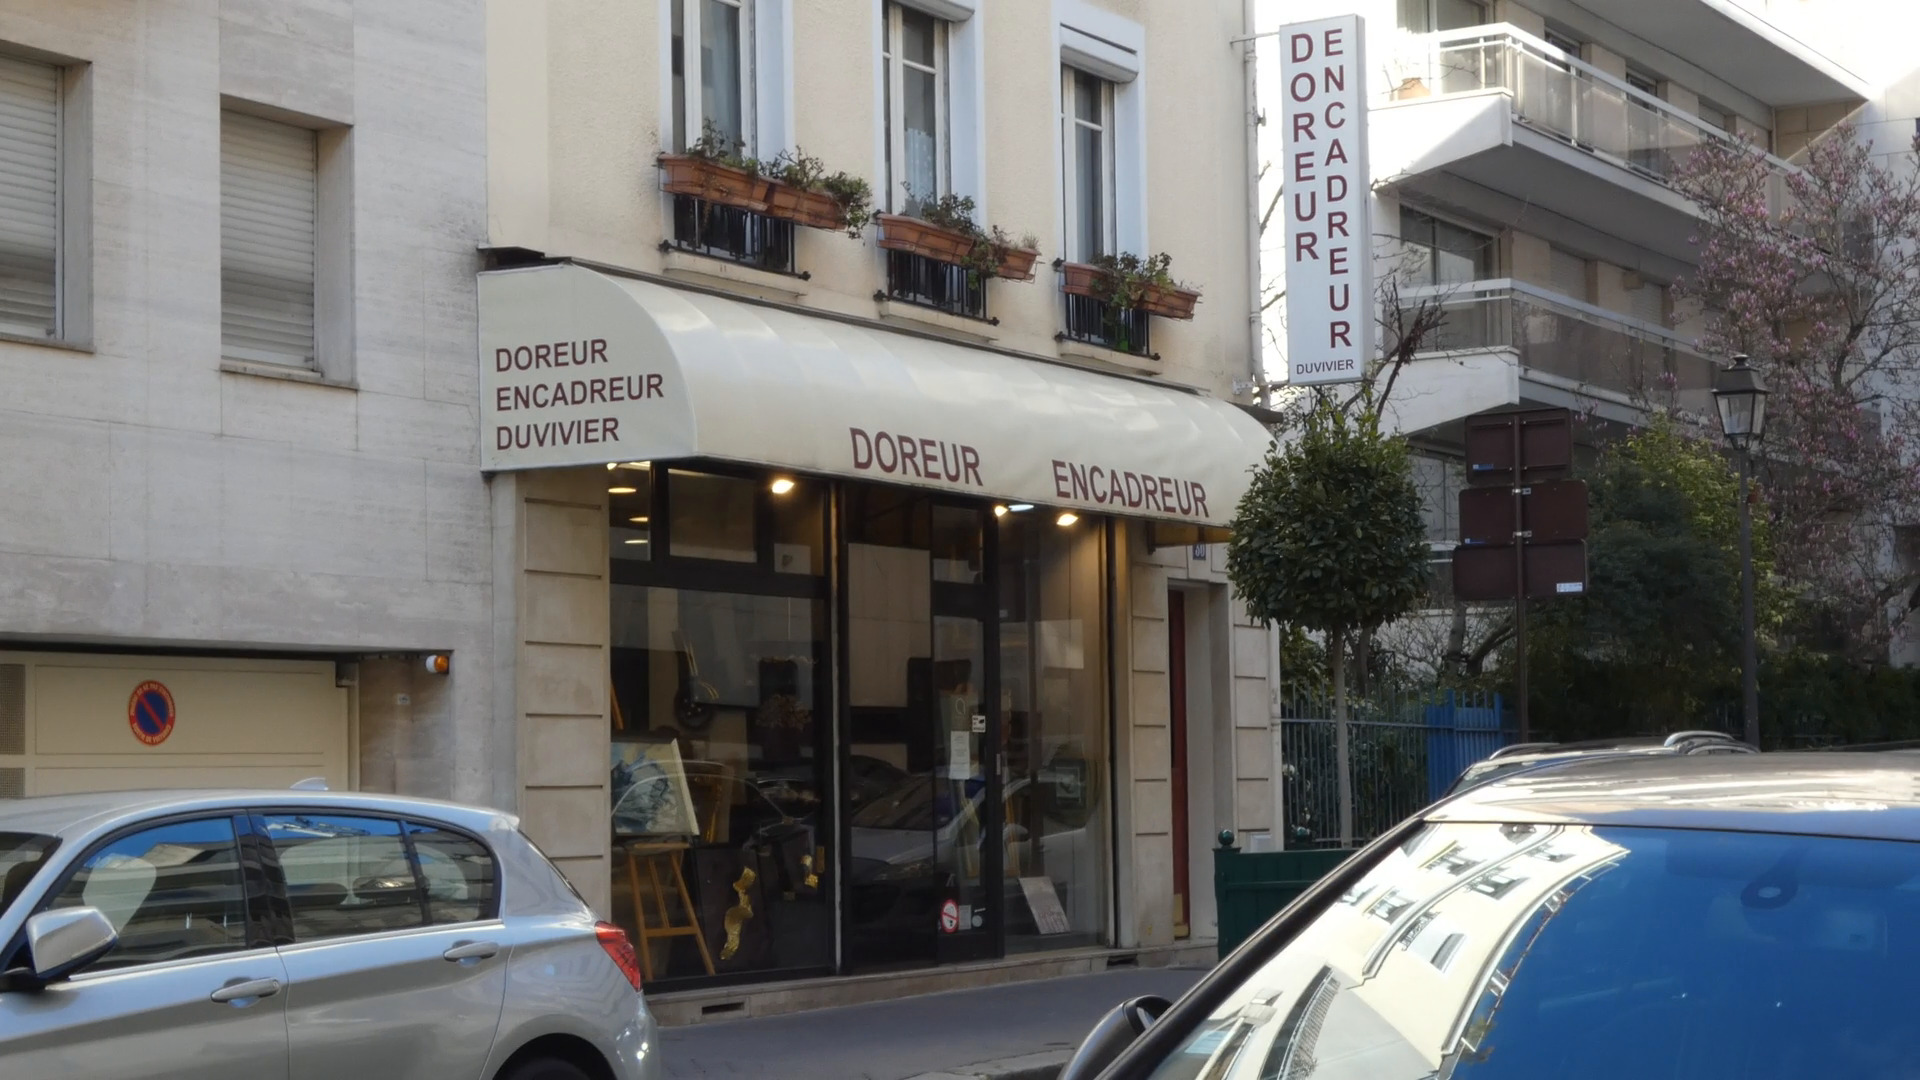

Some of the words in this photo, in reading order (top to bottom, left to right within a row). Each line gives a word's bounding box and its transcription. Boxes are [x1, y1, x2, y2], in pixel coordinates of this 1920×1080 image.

[1290, 33, 1320, 262] DOREUR
[1324, 28, 1352, 349] ENCADREUR
[495, 338, 608, 373] DOREUR
[1296, 359, 1354, 375] DUVIVIER
[496, 373, 664, 411] ENCADREUR
[496, 417, 619, 450] DUVIVIER
[849, 427, 983, 487] DOREUR
[1051, 459, 1210, 518] ENCADREUR
